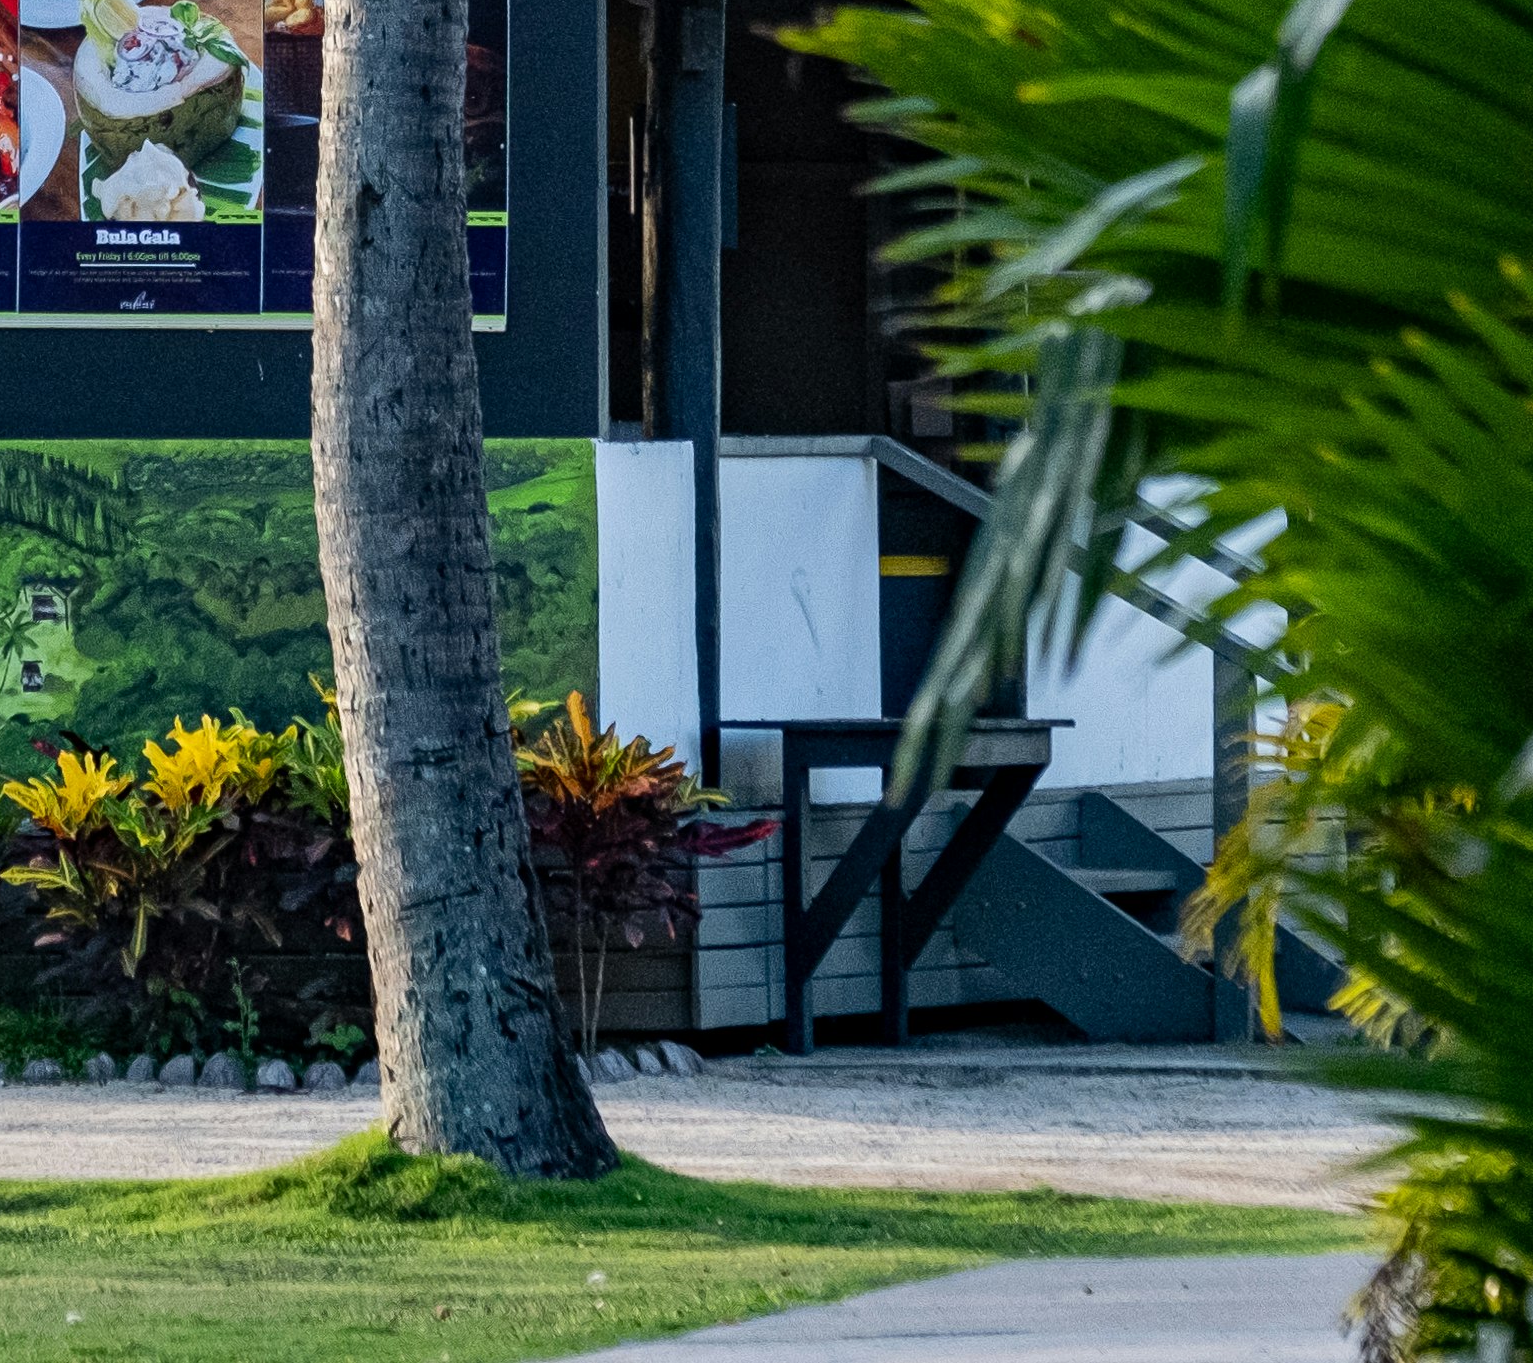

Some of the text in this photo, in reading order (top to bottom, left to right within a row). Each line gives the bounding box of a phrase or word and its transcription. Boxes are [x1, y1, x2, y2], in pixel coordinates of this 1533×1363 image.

[96, 229, 180, 245] Bula Gala
[76, 252, 96, 262] Every
[98, 252, 121, 262] Friday
